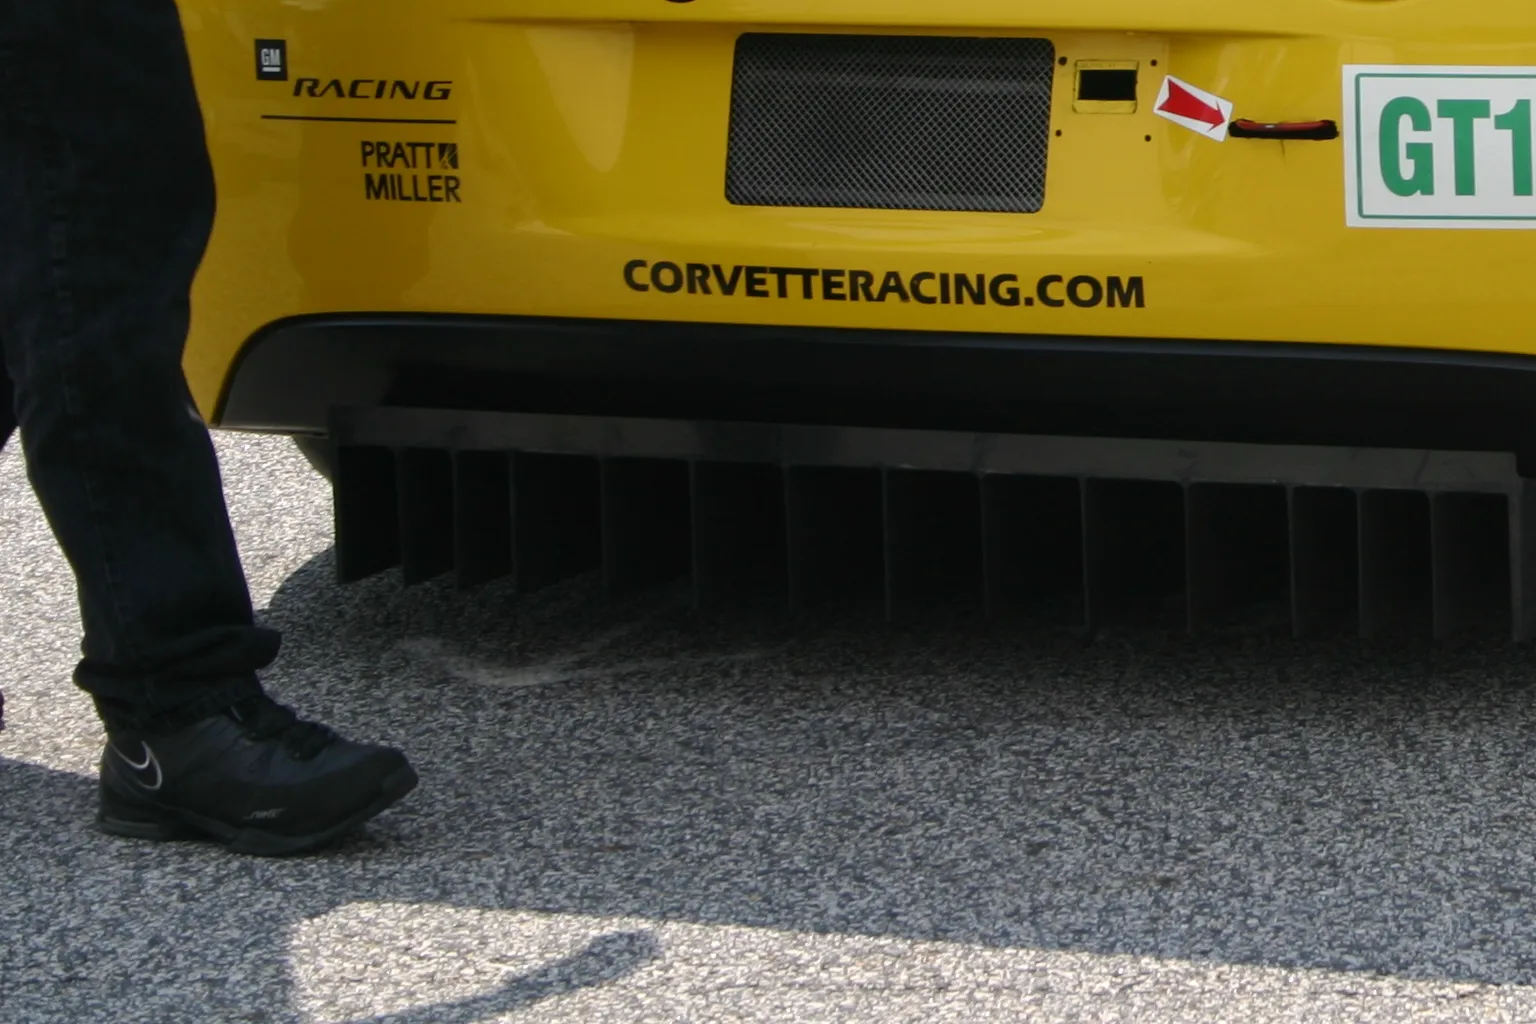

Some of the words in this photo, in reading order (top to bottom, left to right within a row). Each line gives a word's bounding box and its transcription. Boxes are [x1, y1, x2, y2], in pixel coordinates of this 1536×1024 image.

[260, 47, 282, 67] GM
[292, 77, 454, 101] RACING
[360, 140, 436, 169] PRATT
[1378, 95, 1534, 198] GT1
[364, 173, 462, 204] MILLER
[622, 259, 1147, 309] CORVETTERACING.COM
